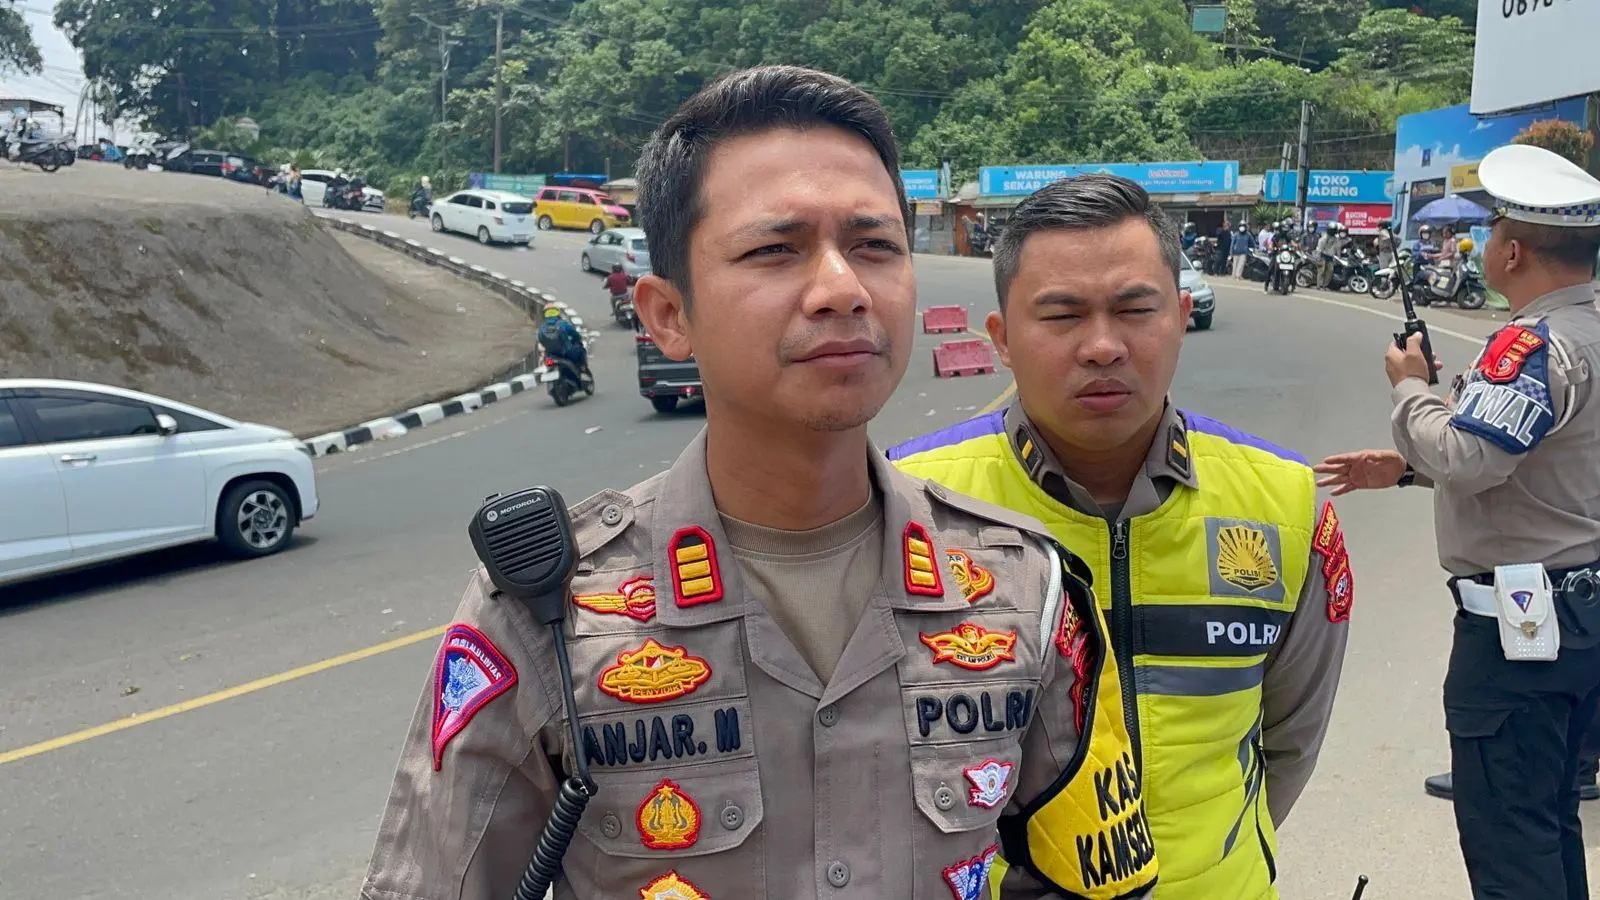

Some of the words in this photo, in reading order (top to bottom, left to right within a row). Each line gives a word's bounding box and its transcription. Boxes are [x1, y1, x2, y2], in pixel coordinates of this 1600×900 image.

[1015, 170, 1067, 180] WARUNG
[1312, 175, 1350, 186] TOKO
[1003, 181, 1041, 191] SEKAR
[500, 497, 541, 516] MOTOROLA
[1233, 568, 1261, 578] POLISI
[915, 688, 1034, 738] POLRI
[582, 713, 707, 767] ANJAR.
[714, 706, 741, 753] M
